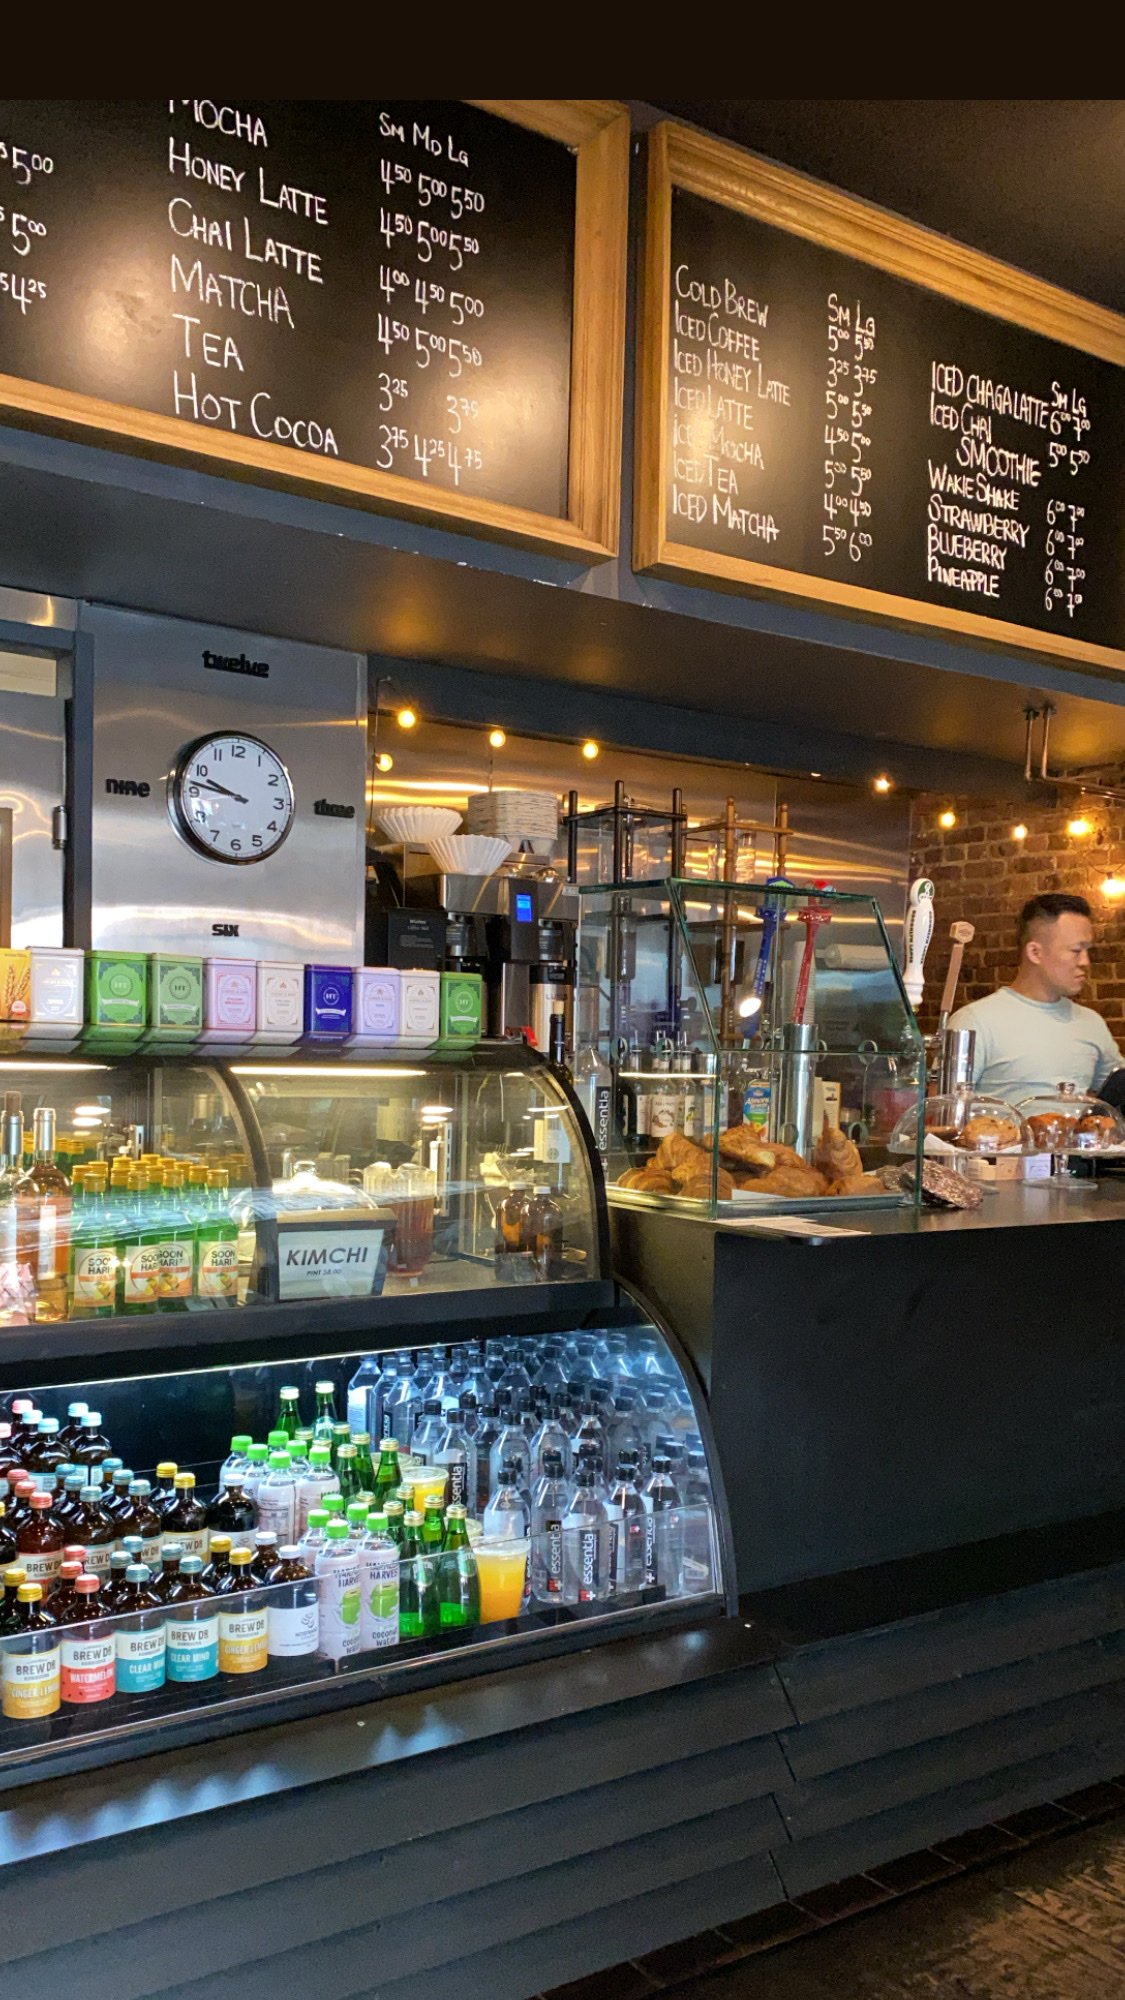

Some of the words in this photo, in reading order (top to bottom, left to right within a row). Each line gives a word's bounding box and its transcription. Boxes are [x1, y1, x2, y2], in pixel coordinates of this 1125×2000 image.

[169, 136, 246, 192] HONEY
[259, 166, 328, 225] LATTE
[168, 198, 232, 250] CHAI
[244, 216, 323, 284] LATTE
[172, 254, 294, 329] MATCHA
[676, 264, 722, 308] COLD
[724, 278, 768, 328] BREW
[172, 313, 244, 372] TEA
[675, 299, 706, 341] ICED
[708, 312, 760, 362] COFFEE
[674, 338, 702, 376] ICED
[707, 348, 752, 392] HONEY
[758, 363, 791, 406] LATTE
[932, 360, 964, 397] ICED
[966, 374, 1012, 415] CHAGA
[1014, 391, 1049, 429] LATTE
[174, 370, 242, 430] HOT
[251, 392, 339, 455] COCOA
[708, 384, 754, 430] LATTE
[930, 391, 959, 430] ICED
[961, 402, 992, 444] CHAI
[704, 452, 738, 495] TEA
[956, 436, 1042, 487] SMOOTHIE
[976, 472, 1020, 510] SHAKE
[672, 484, 708, 524] ICED
[712, 494, 780, 544] MATCHA
[928, 493, 1030, 548] STRAWBERRY
[928, 523, 1007, 570] BLUEBERRY
[928, 556, 1000, 598] PINEAPPLE
[202, 650, 269, 678] twelve
[214, 748, 222, 761] 11
[231, 745, 246, 758] 12
[196, 764, 208, 776] 10
[268, 774, 279, 786] 2
[106, 778, 150, 797] nine
[188, 786, 200, 798] 9
[273, 798, 284, 810] 3
[314, 798, 355, 818] three
[210, 830, 220, 842] 7
[267, 821, 277, 832] 4
[230, 839, 242, 850] 6
[252, 836, 263, 846] 5
[212, 924, 240, 938] six
[598, 1090, 609, 1150] essentia
[88, 1258, 111, 1266] SOO
[286, 1248, 368, 1266] KIMCHI
[451, 1466, 462, 1504] sentia
[86, 1555, 102, 1565] REW
[551, 1524, 562, 1573] essentia
[582, 1532, 594, 1585] essentia
[26, 1562, 52, 1573] BREW
[171, 1630, 196, 1641] BREW
[229, 1622, 256, 1633] BREW
[74, 1648, 102, 1660] BREW
[130, 1640, 156, 1652] BREW
[16, 1662, 46, 1676] BREW
[129, 1662, 152, 1674] CLEAR
